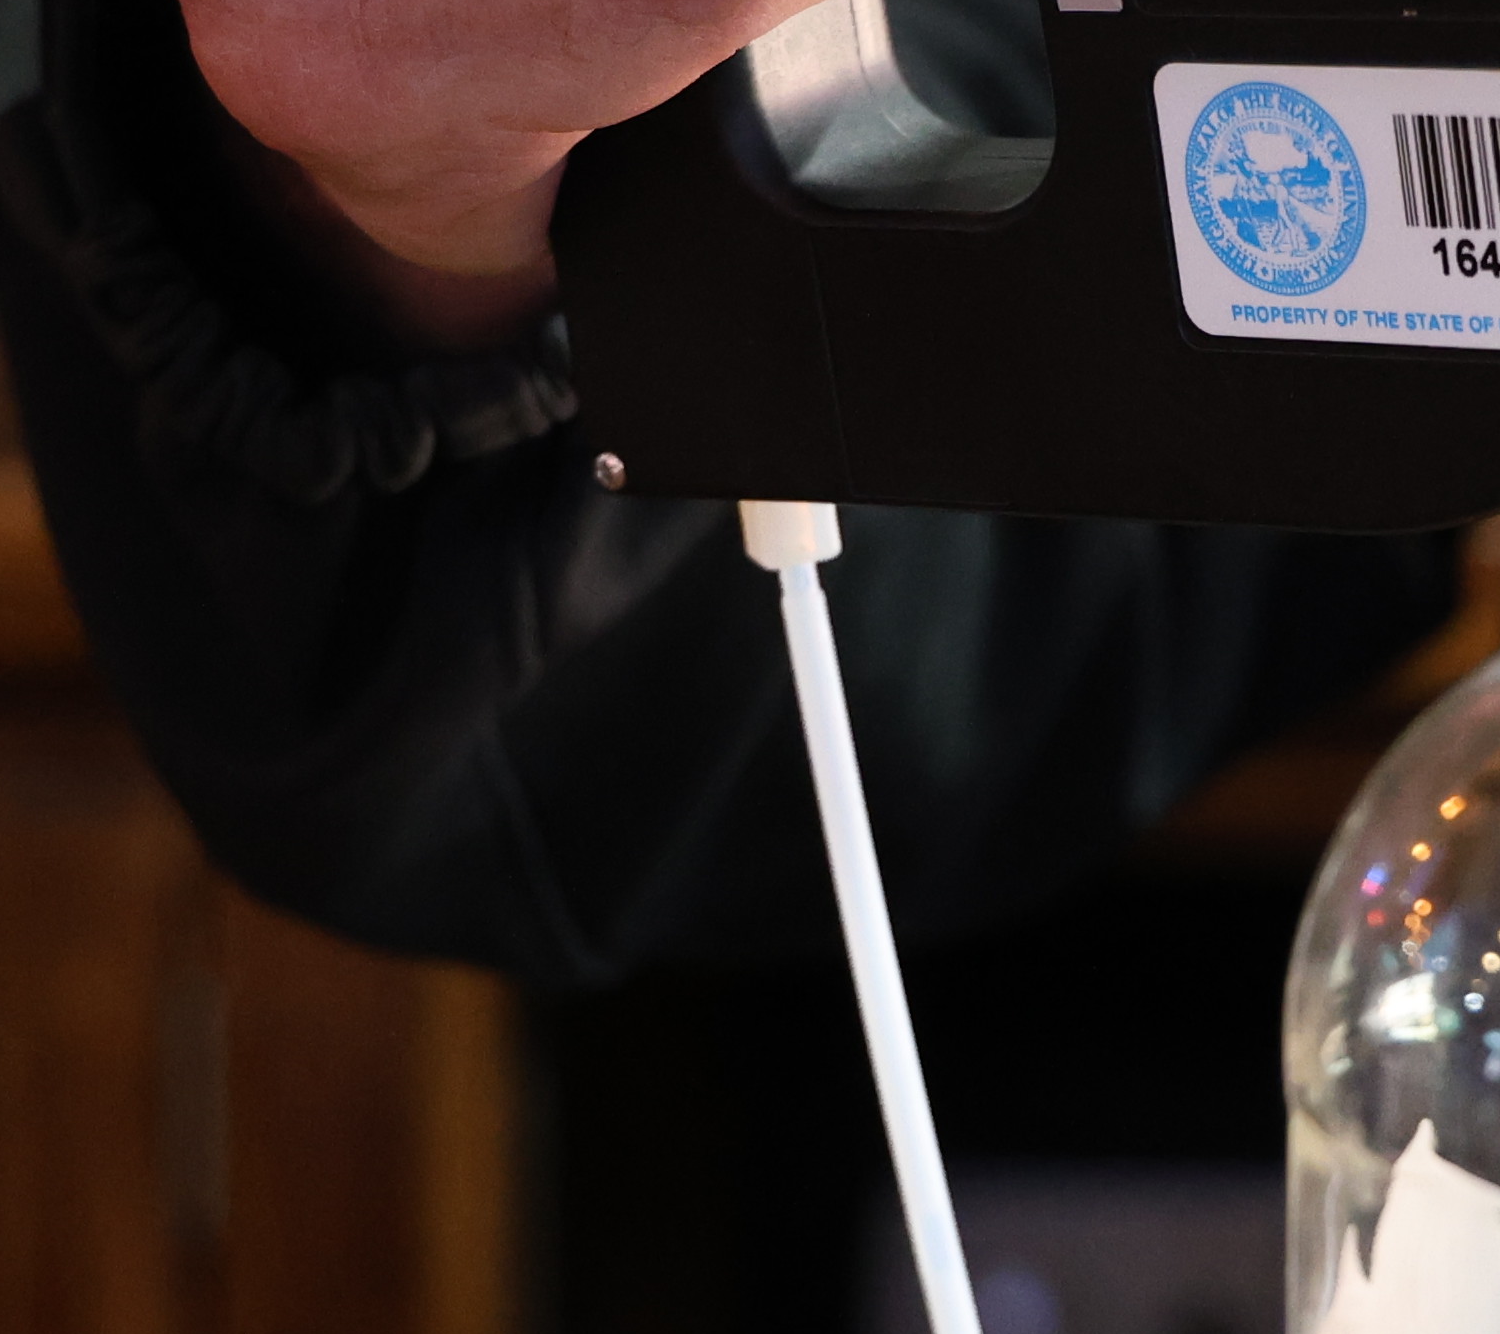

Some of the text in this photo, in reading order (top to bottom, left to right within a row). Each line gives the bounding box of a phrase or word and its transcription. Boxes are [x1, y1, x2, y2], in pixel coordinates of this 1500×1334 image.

[1231, 304, 1328, 326] PROPERTY
[1334, 309, 1359, 327] OF
[1363, 310, 1399, 329] THE
[1405, 313, 1463, 332] STATE
[1469, 315, 1495, 334] OF
